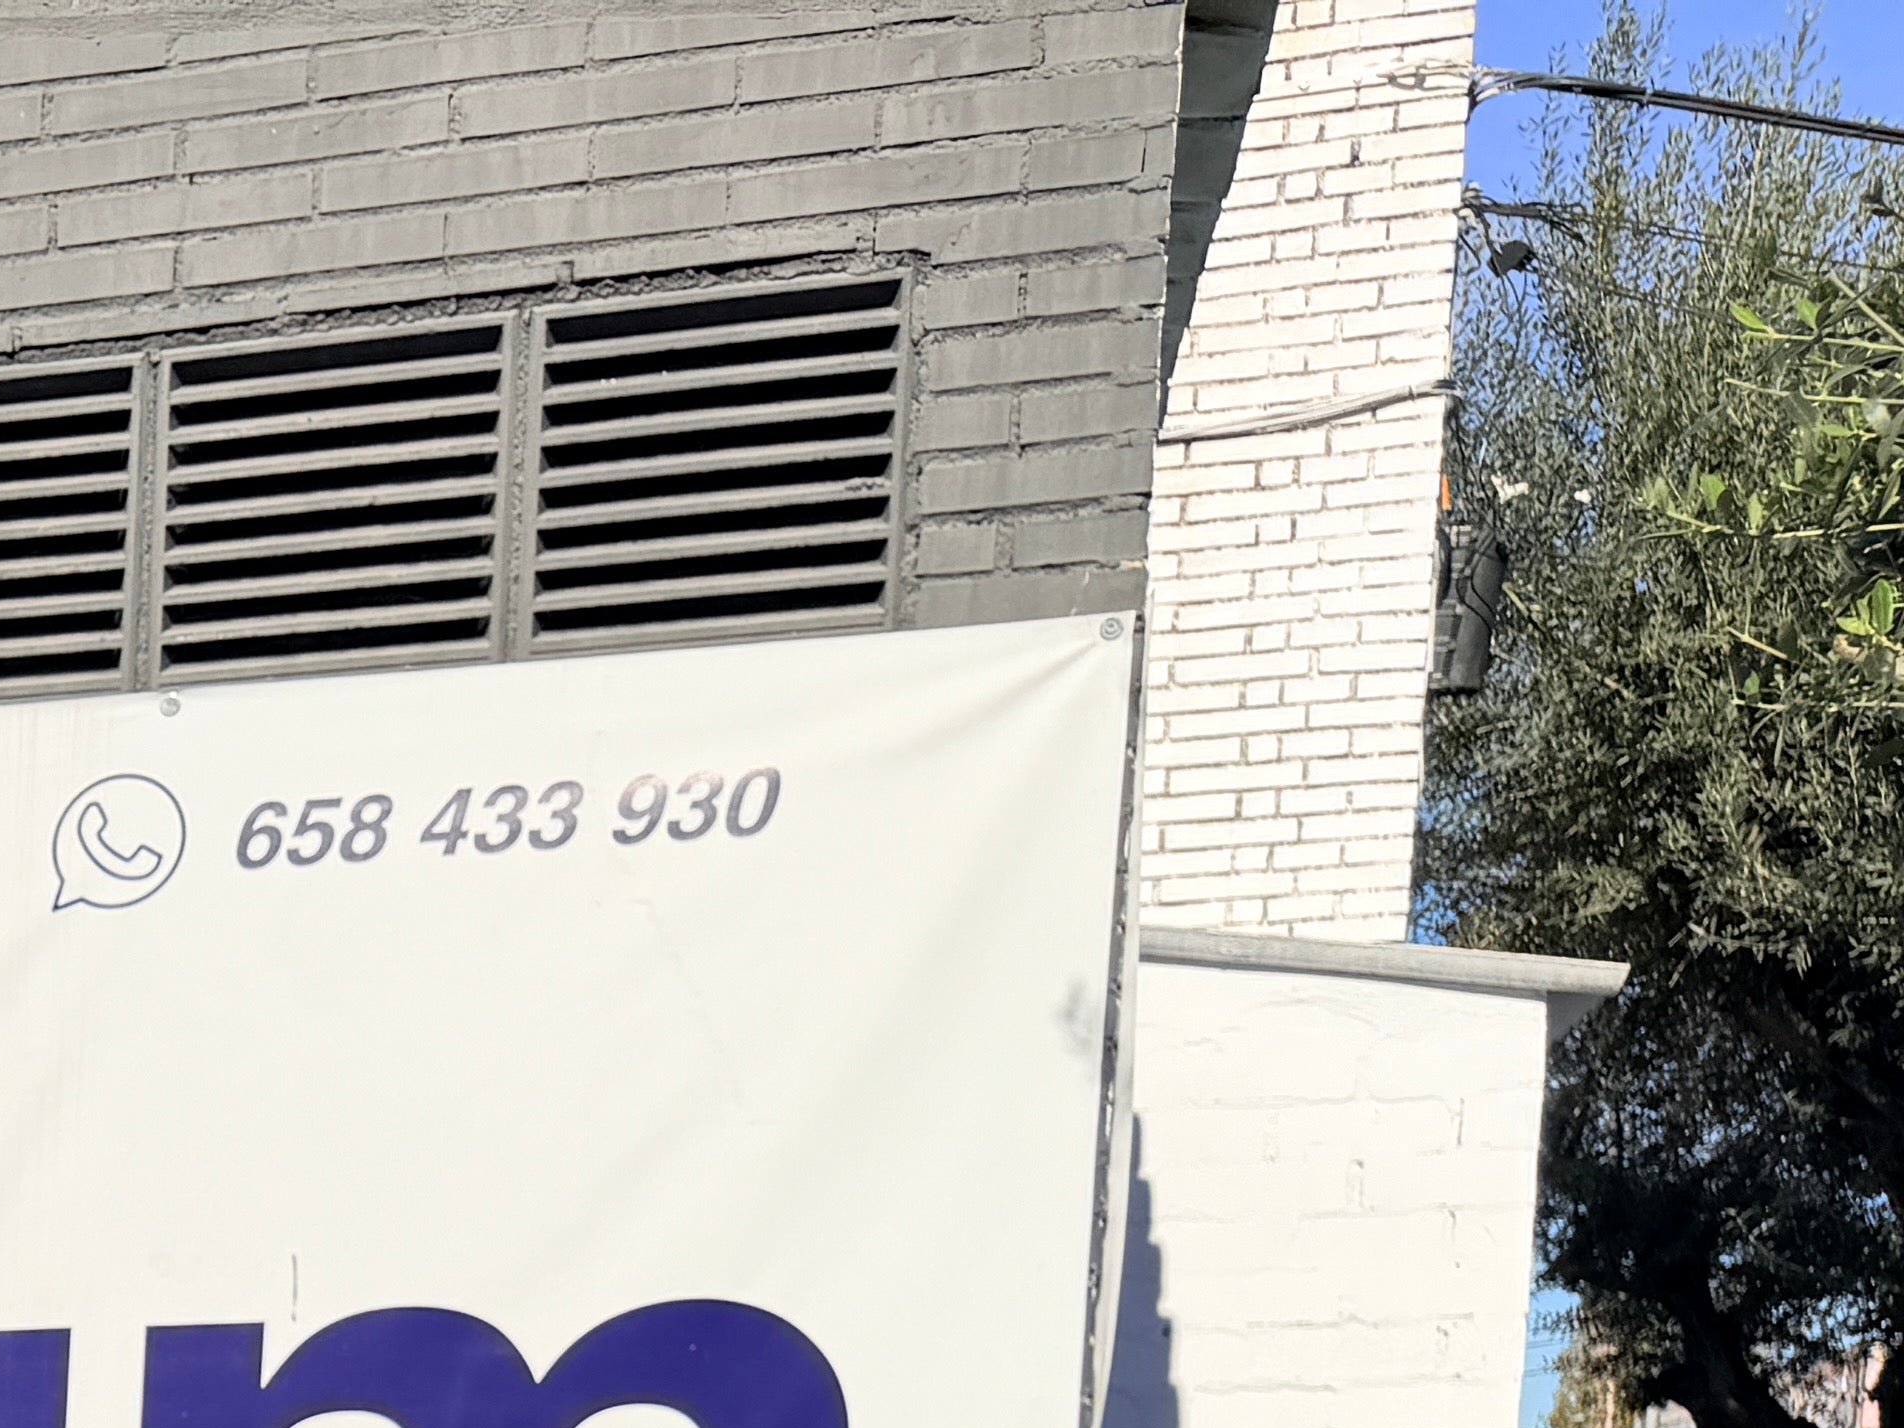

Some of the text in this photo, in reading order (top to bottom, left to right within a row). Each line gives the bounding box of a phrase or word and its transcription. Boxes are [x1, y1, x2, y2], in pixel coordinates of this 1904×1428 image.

[236, 766, 781, 870] 658 433 930
